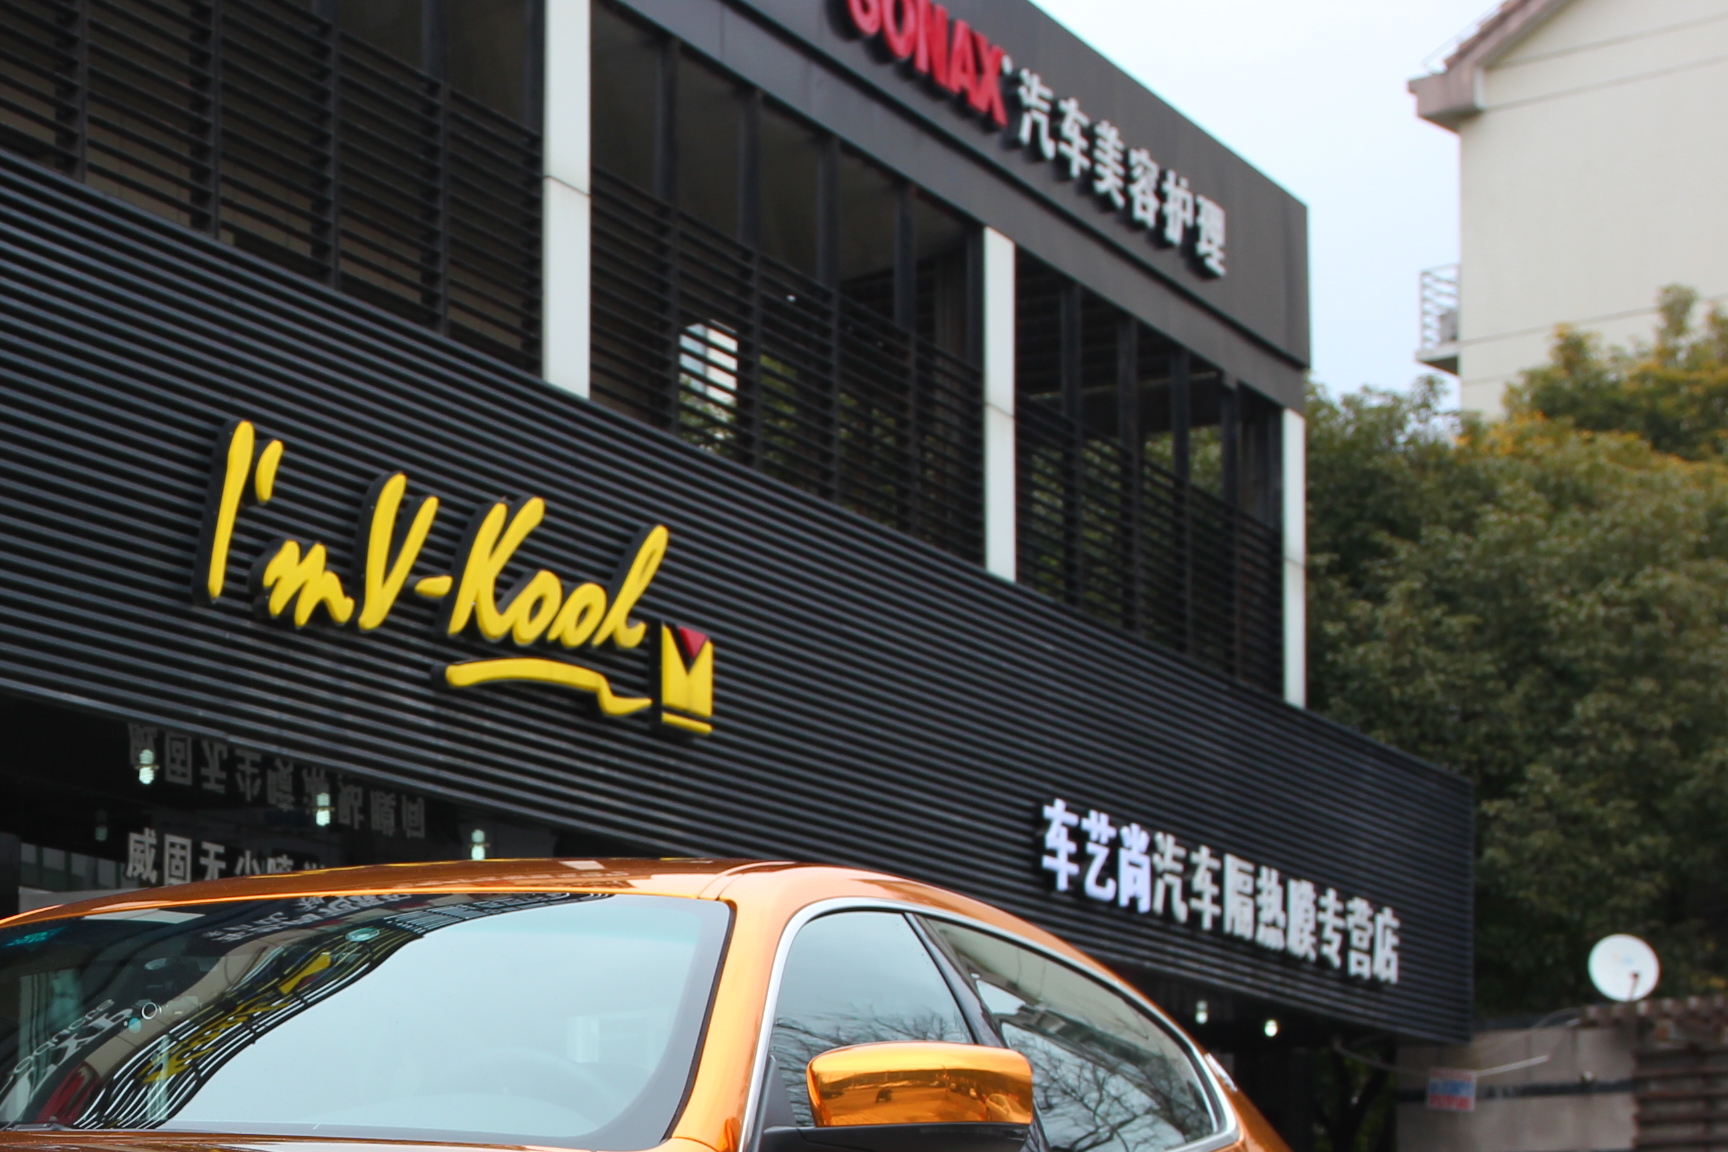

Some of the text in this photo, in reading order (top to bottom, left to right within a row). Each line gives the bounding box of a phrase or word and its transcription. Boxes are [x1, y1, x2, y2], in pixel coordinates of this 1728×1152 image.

[1017, 67, 1227, 277] 汽车美容护理
[207, 420, 355, 627] I'm
